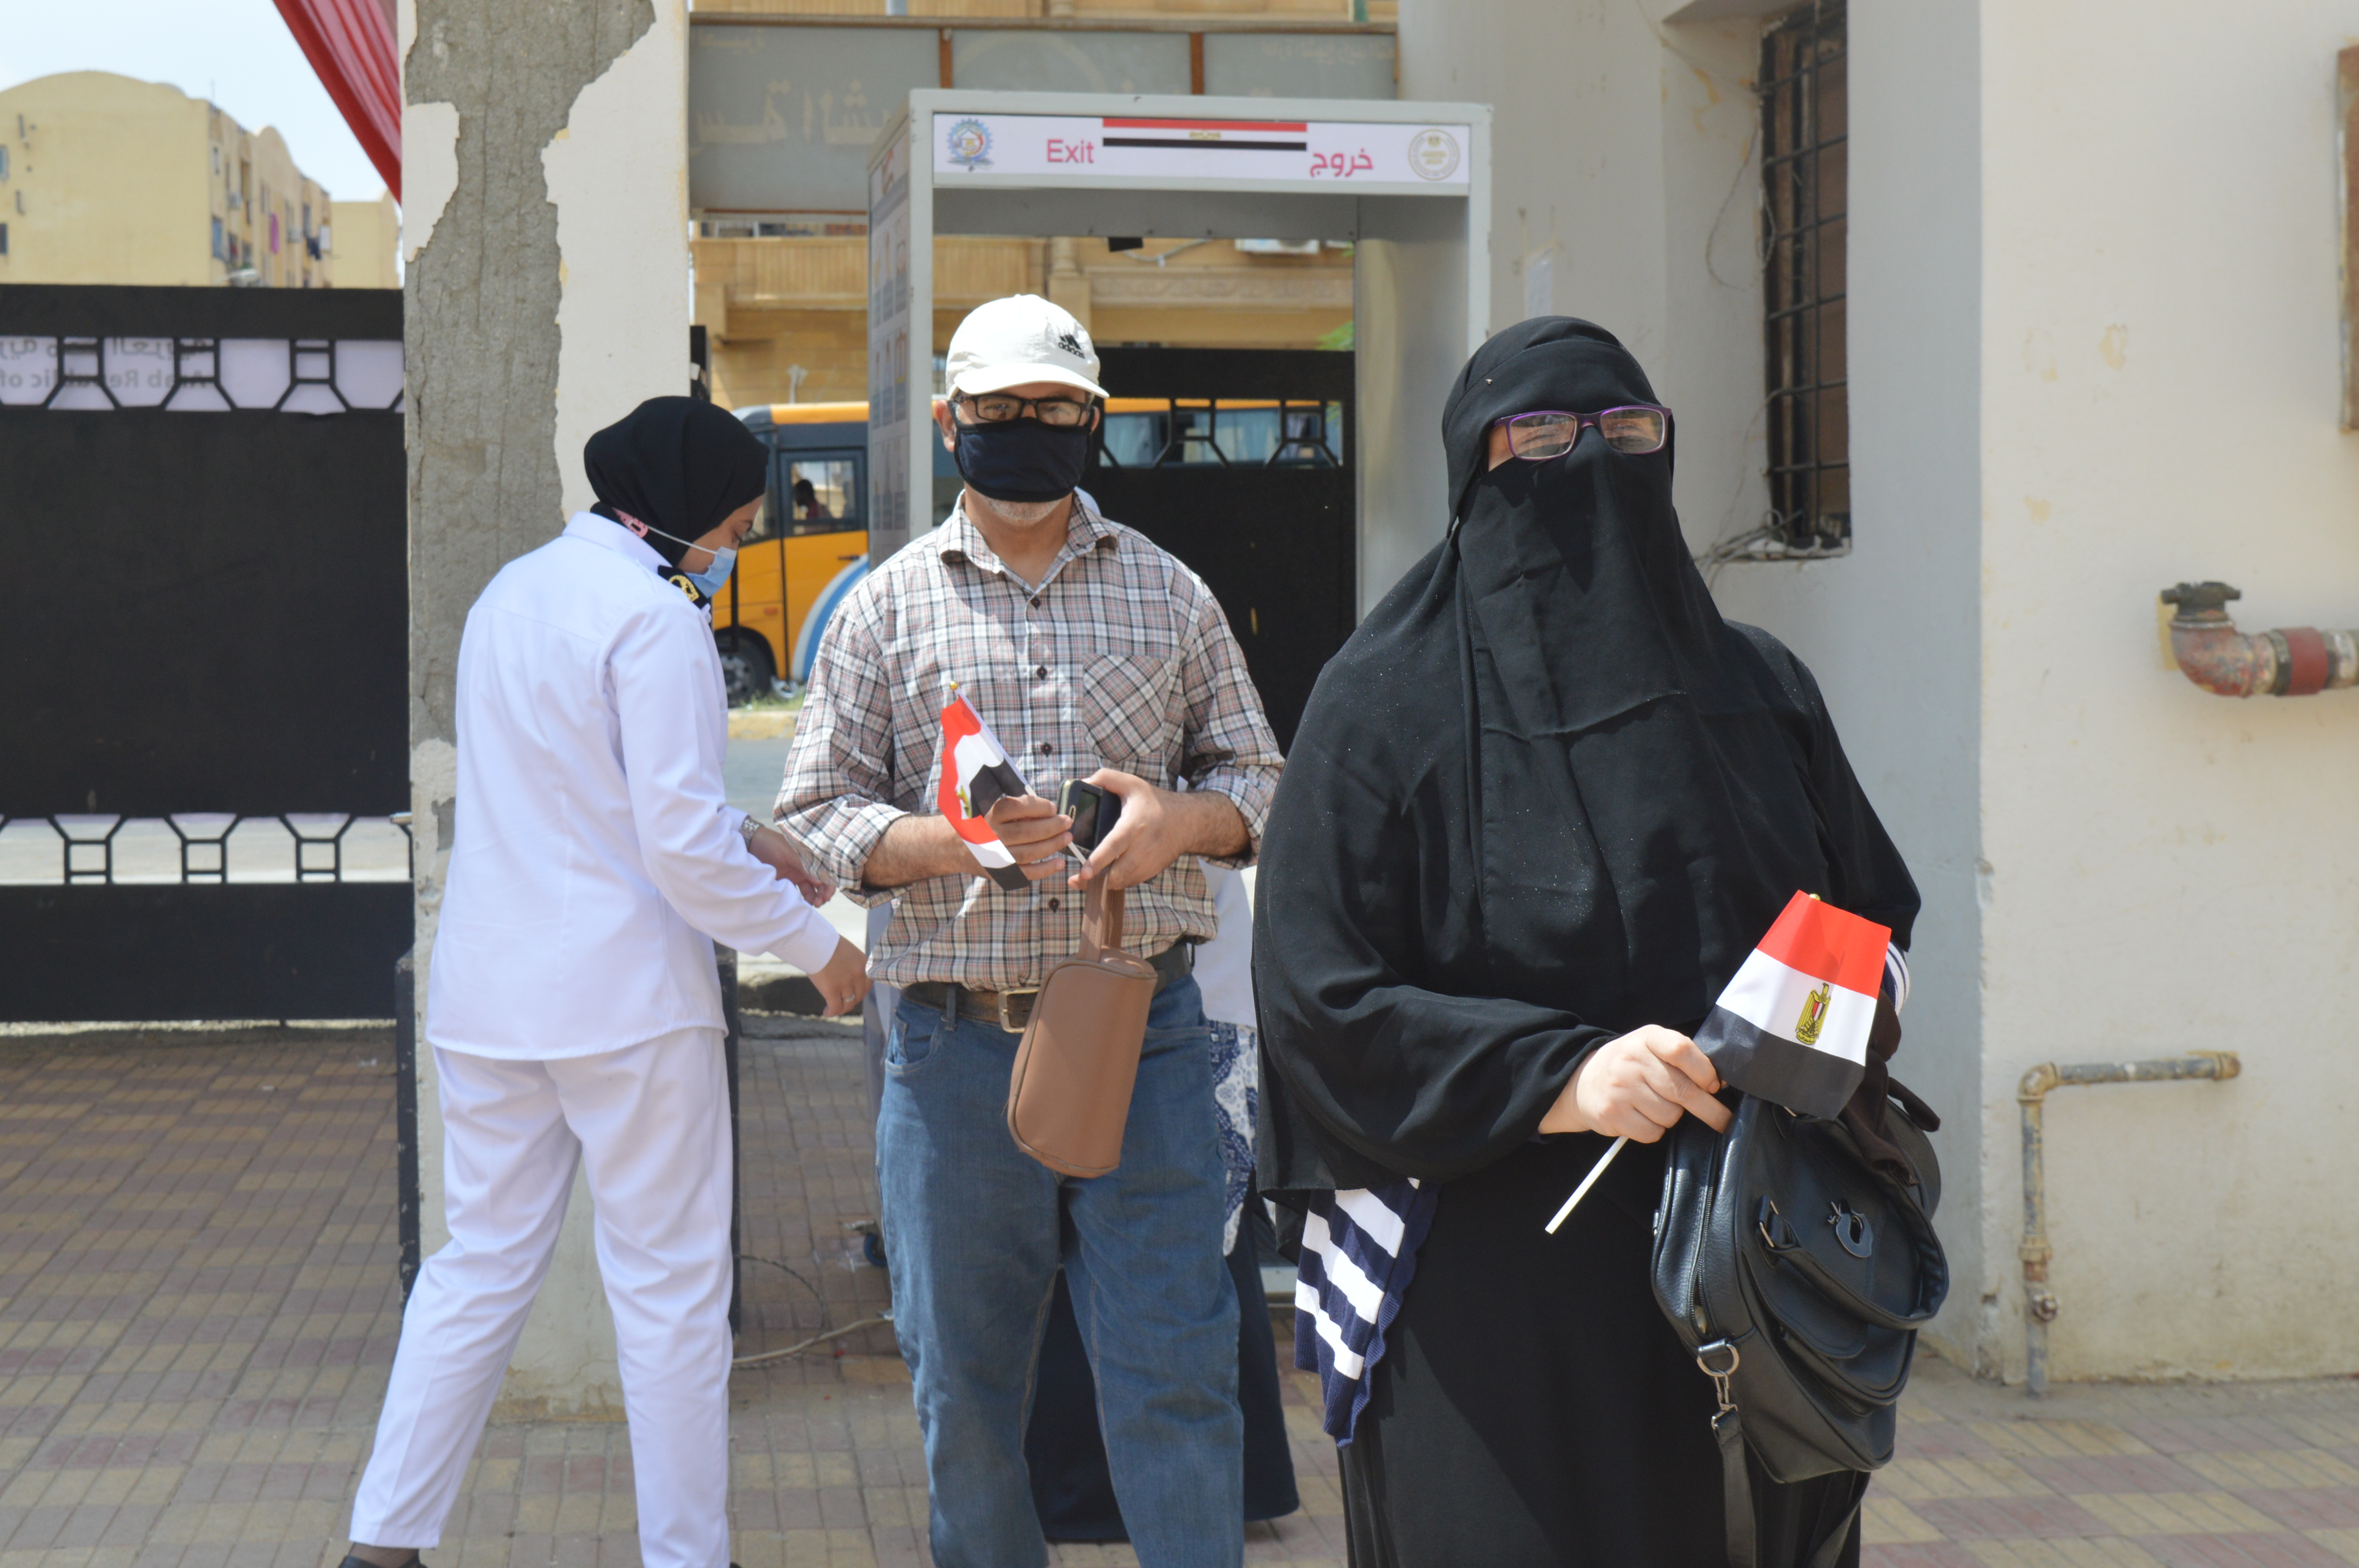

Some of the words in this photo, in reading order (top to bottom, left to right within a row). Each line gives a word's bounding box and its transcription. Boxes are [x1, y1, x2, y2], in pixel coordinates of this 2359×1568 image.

[1047, 139, 1094, 163] Exit
[1310, 147, 1374, 177] خروج
[1058, 342, 1085, 359] adidas
